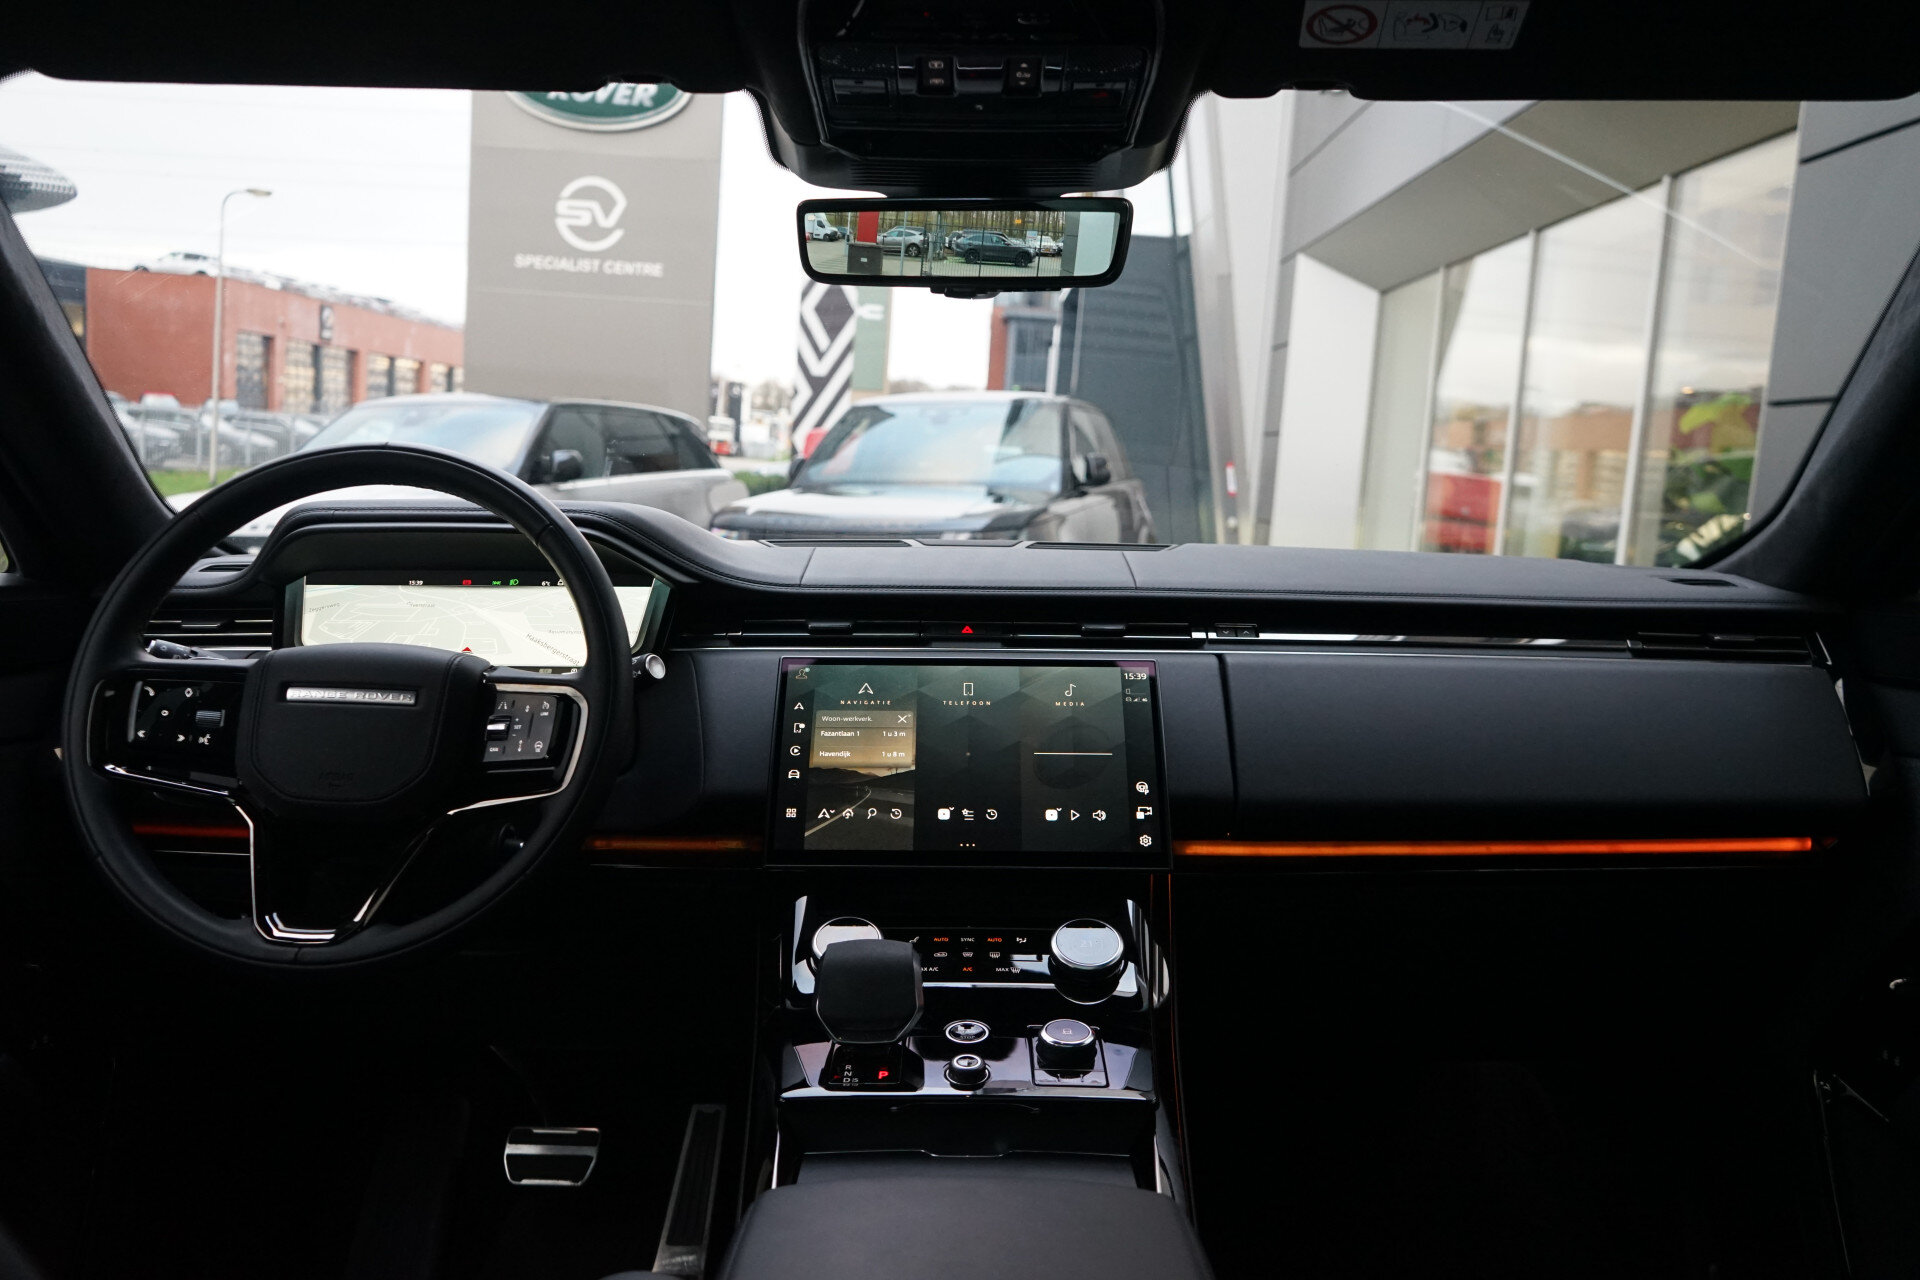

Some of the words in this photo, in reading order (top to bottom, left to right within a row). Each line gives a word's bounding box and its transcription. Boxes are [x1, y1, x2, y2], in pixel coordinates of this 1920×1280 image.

[513, 253, 600, 273] SPECIALIST
[602, 259, 665, 278] CENTRE
[1123, 672, 1147, 680] 15:39
[290, 689, 347, 699] RANGE
[354, 691, 414, 702] ROVER
[819, 750, 851, 758] Havendijk
[878, 1070, 889, 1080] P
